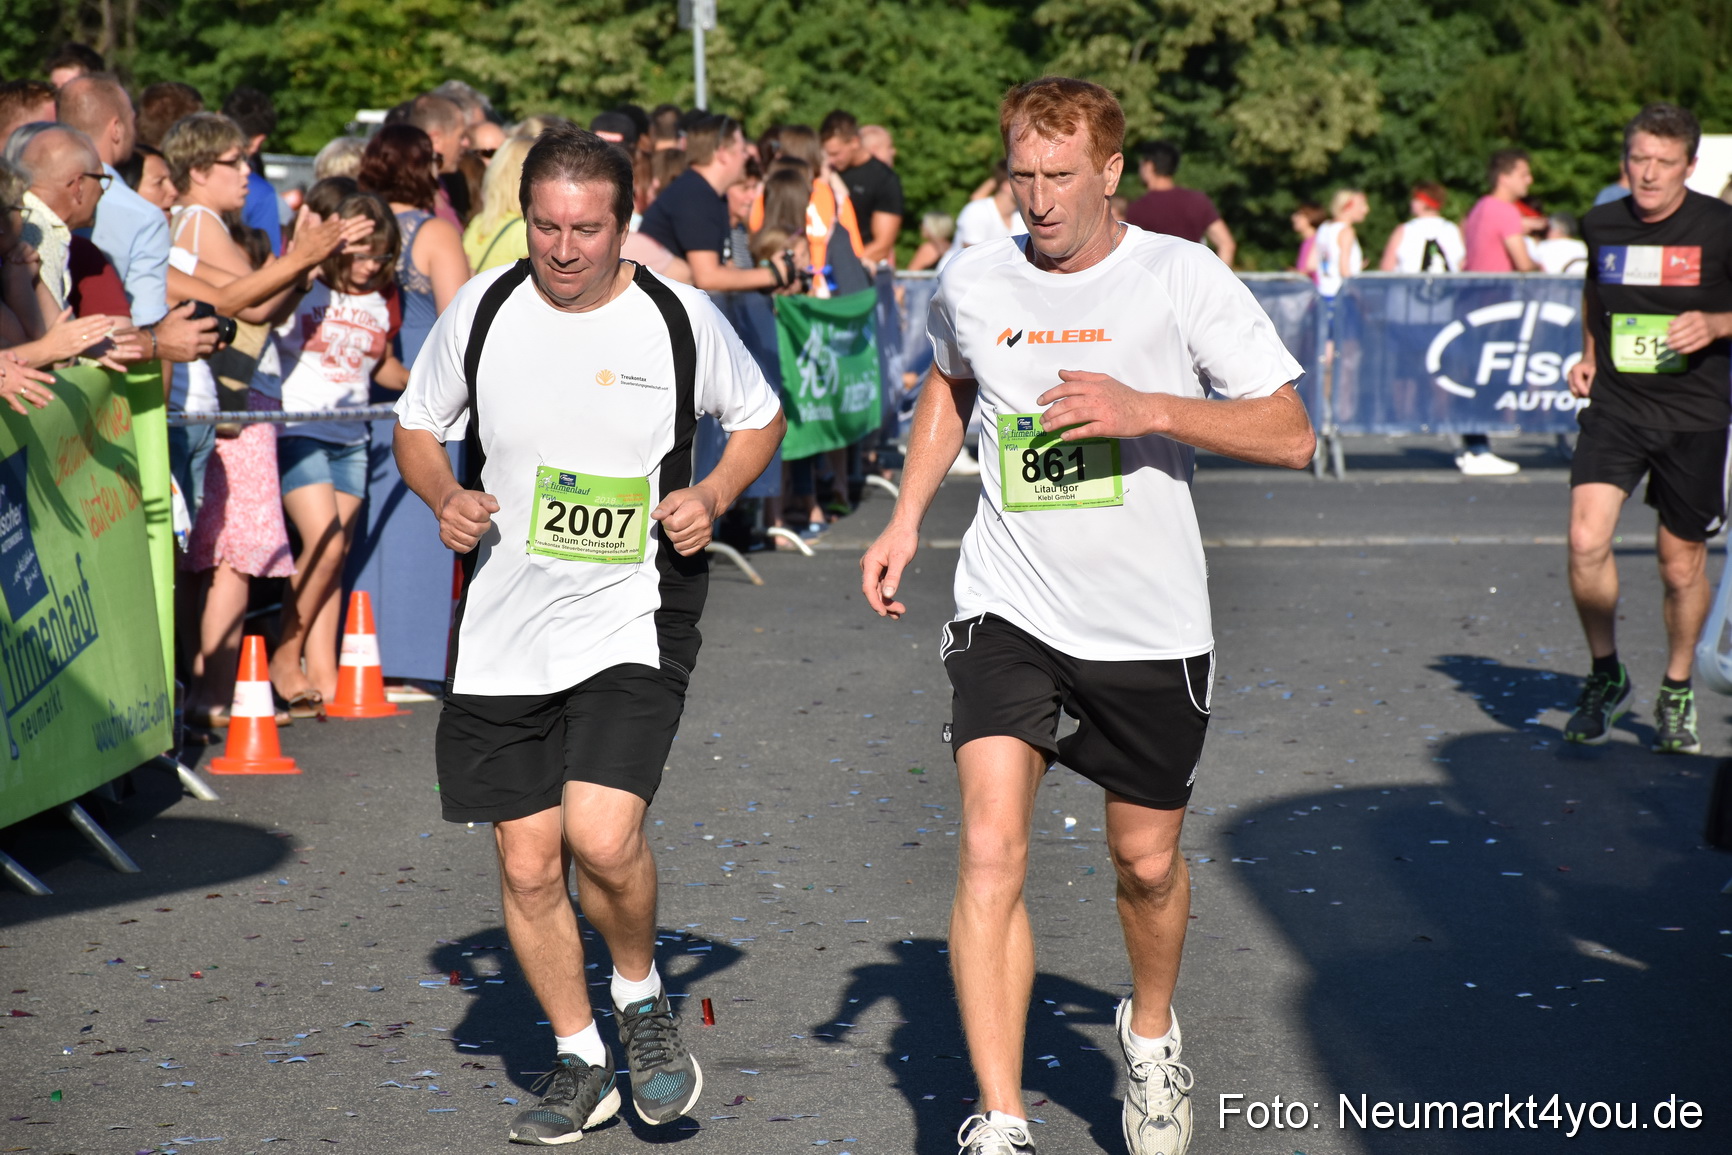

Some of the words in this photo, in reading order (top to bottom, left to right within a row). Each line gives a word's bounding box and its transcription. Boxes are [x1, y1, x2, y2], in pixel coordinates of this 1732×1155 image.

[1028, 329, 1112, 344] KLEBL
[620, 373, 647, 382] Treukontax
[1022, 446, 1085, 483] 861
[550, 481, 592, 496] firmenlauf
[1034, 485, 1057, 494] Litau
[1060, 484, 1079, 495] Igor
[544, 501, 636, 539] 2007
[552, 534, 579, 547] Daum
[581, 538, 625, 550] Christoph
[20, 684, 63, 745] neumarkt
